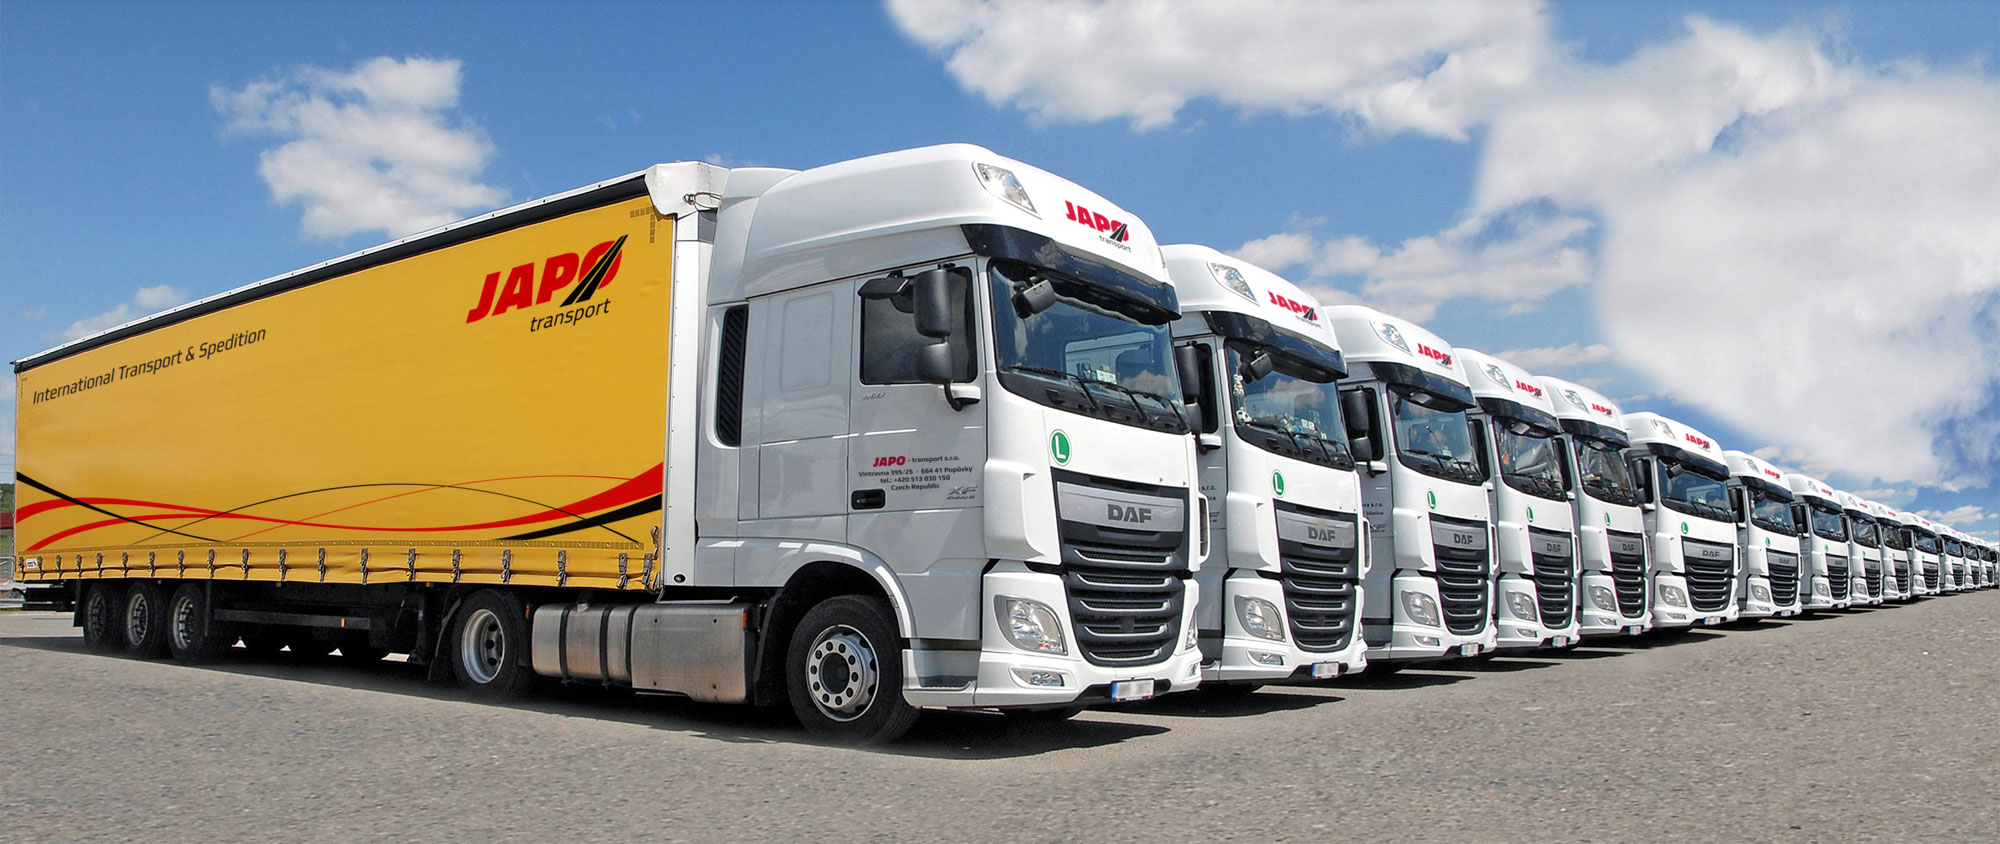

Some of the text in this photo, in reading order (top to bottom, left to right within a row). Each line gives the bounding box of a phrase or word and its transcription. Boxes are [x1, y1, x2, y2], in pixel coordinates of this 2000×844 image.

[1064, 200, 1129, 242] JAPO
[1099, 235, 1132, 252] transport
[466, 240, 623, 324] JAPO
[530, 298, 611, 332] transport
[1268, 290, 1318, 320] JAPO
[1417, 343, 1452, 366] JAPO
[32, 328, 266, 405] International Transport & Spedition
[1054, 434, 1067, 460] L
[872, 456, 906, 468] JAPO
[1108, 504, 1152, 524] DAF
[1308, 526, 1336, 542] DAF
[1453, 533, 1473, 544] DAF
[1702, 549, 1720, 558] DAF
